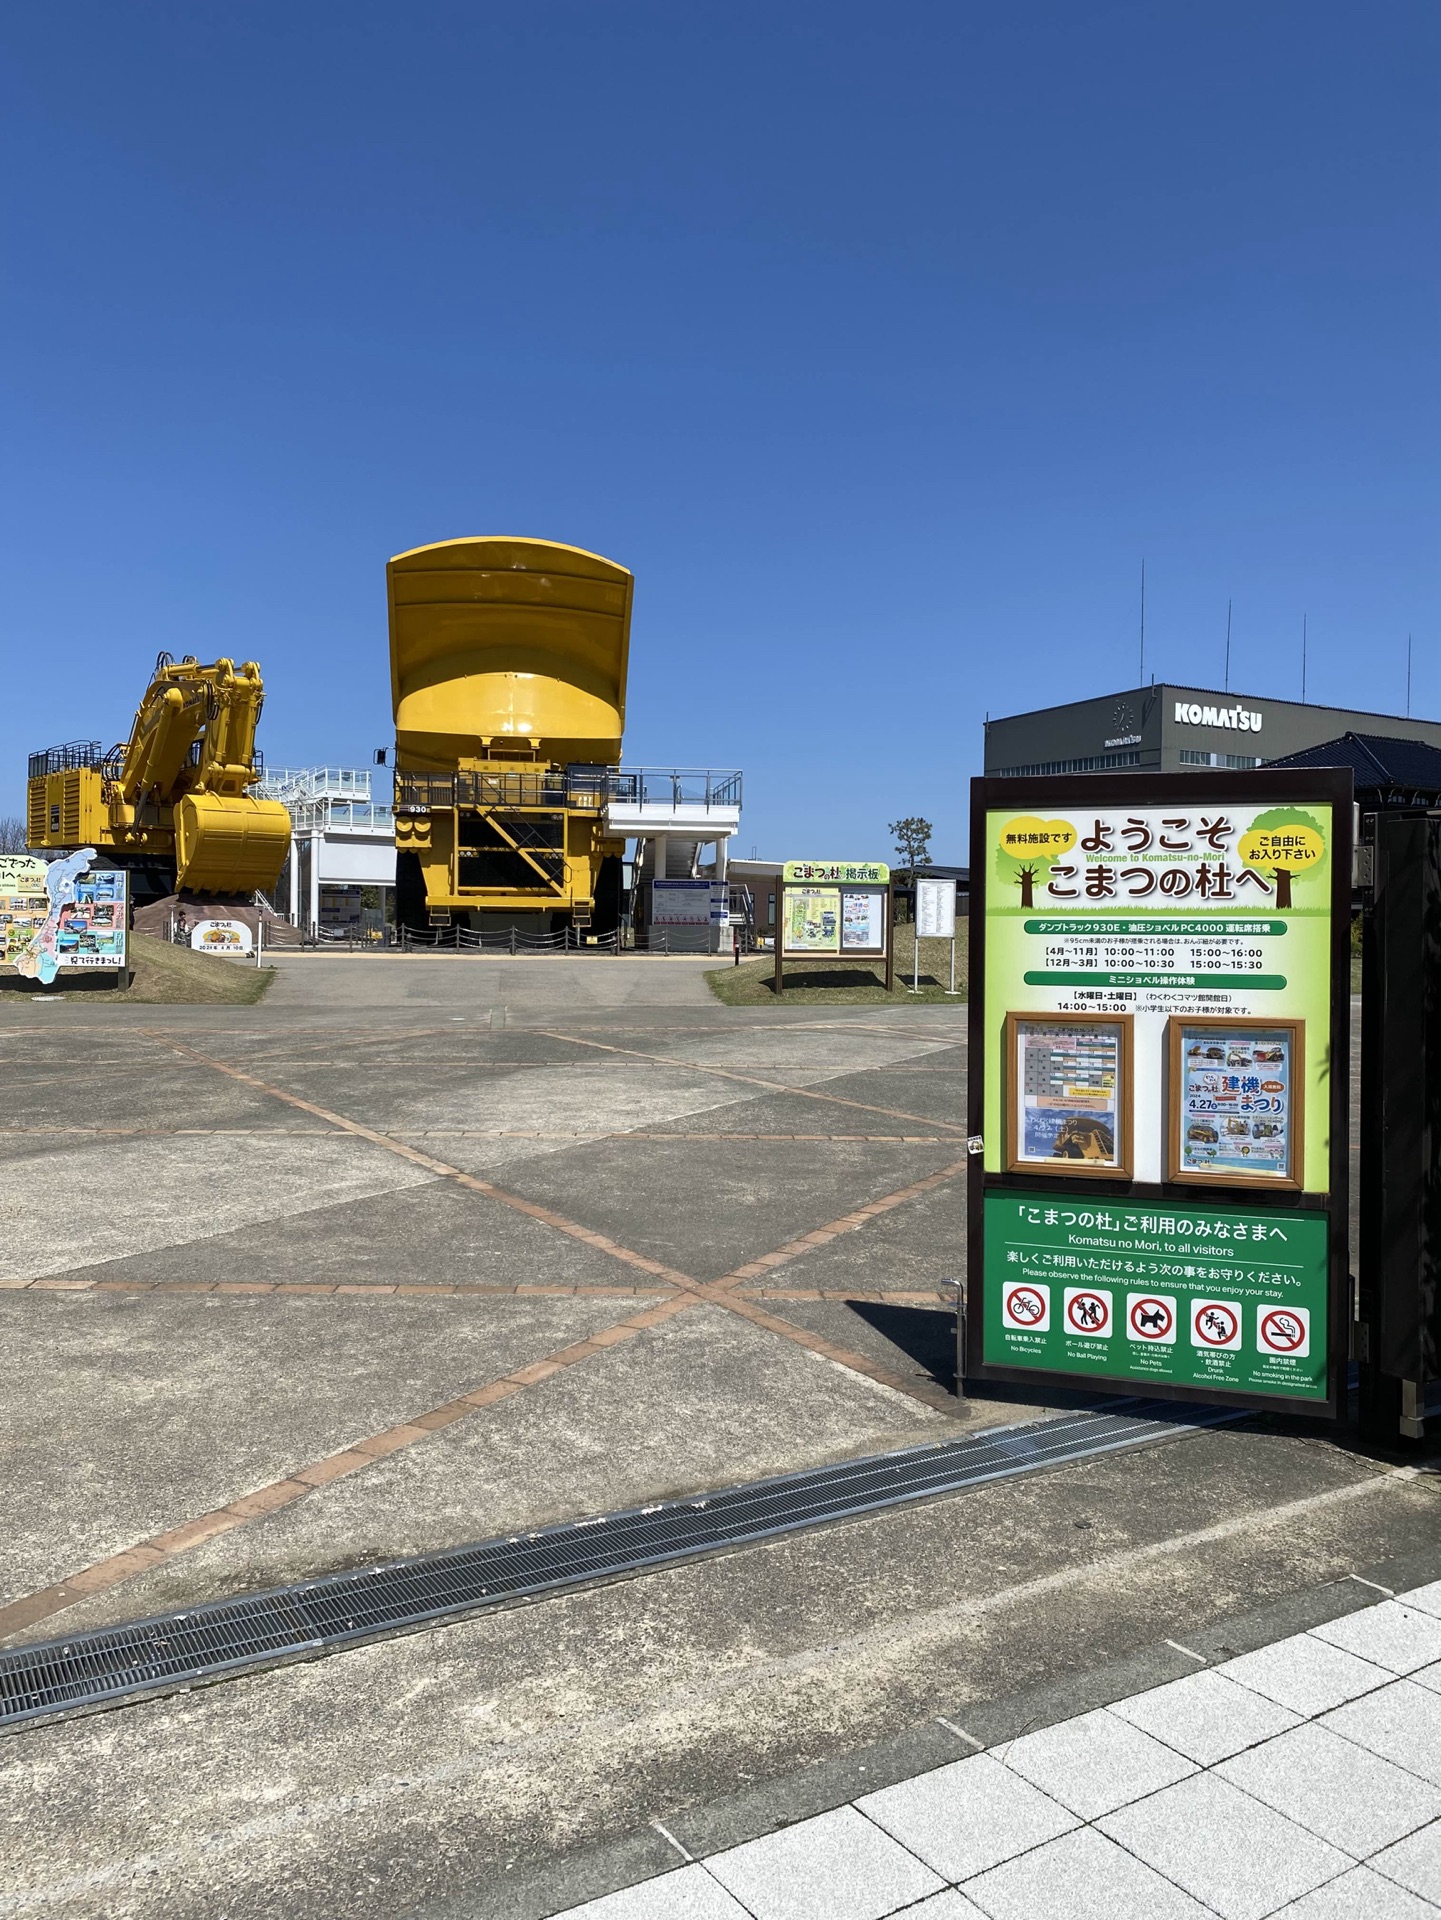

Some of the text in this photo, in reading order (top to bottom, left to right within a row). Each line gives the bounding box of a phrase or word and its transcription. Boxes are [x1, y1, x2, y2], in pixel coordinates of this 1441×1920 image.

[1175, 702, 1262, 733] KOMATSU
[1006, 833, 1072, 844] 無料施設です
[1081, 817, 1232, 851] ようこそ
[1260, 836, 1306, 847] ご自由に
[1086, 852, 1225, 862] Welcome to Komatsu-no-Mori
[1249, 849, 1316, 860] お入り下さい
[845, 868, 880, 880] 掲示板
[1047, 863, 1271, 898] こまつの杜へ
[1109, 975, 1196, 985] ミニショベル操作体験
[1221, 1075, 1262, 1095] 建機
[1240, 1095, 1283, 1113] まつり
[1068, 1234, 1234, 1257] Komatsu no Mori, to all visitors
[1006, 1250, 1302, 1287] 楽しくご利用いただけるよう次の事をお守りください。
[1022, 1268, 1284, 1299] Please observe the following rules to ensure that you enjoy your stay.
[1019, 1346, 1042, 1355] Bicycles
[1086, 1354, 1107, 1362] Playing
[1140, 1358, 1163, 1367] No Pets
[1193, 1373, 1212, 1381] Alcohol
[1261, 1372, 1285, 1381] smoking
[1300, 1375, 1313, 1383] park
